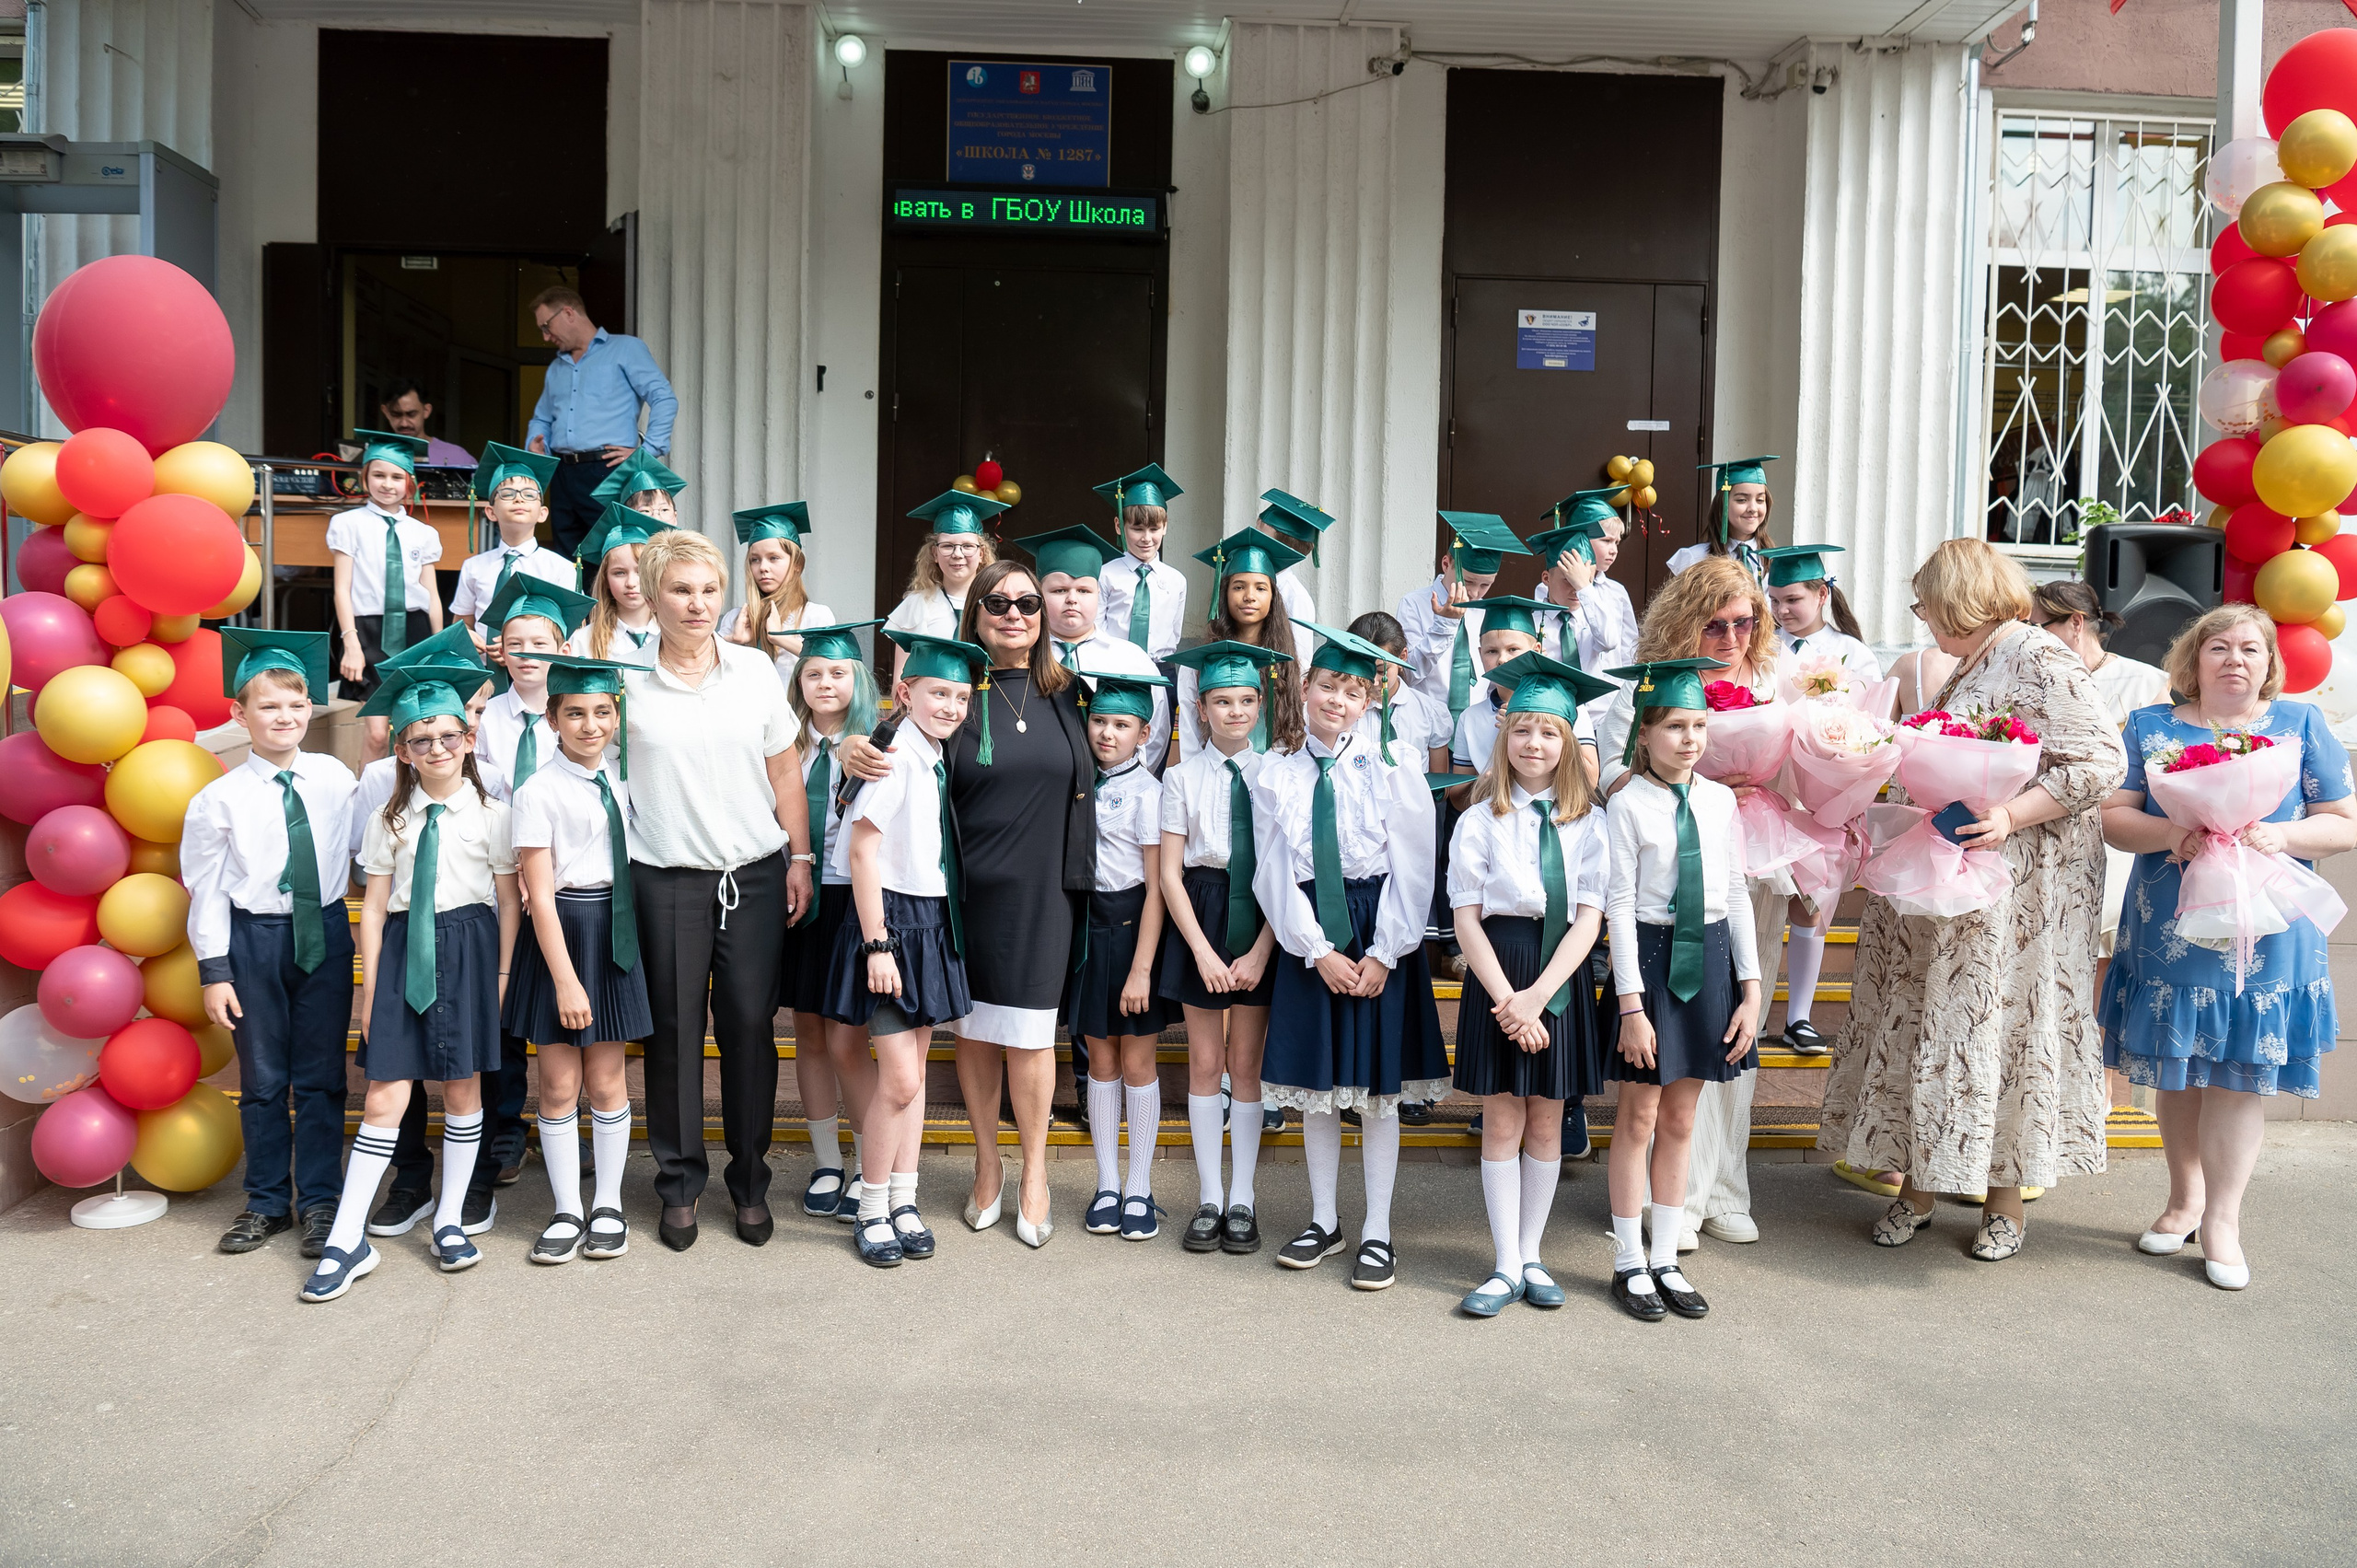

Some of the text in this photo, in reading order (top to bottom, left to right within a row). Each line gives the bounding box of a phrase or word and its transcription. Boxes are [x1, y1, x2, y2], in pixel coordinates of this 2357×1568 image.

[956, 145, 1102, 162] «ШКОЛА № 1287»
[961, 202, 974, 219] в
[993, 197, 1062, 222] ГБОУ
[1070, 200, 1145, 226] Школа
